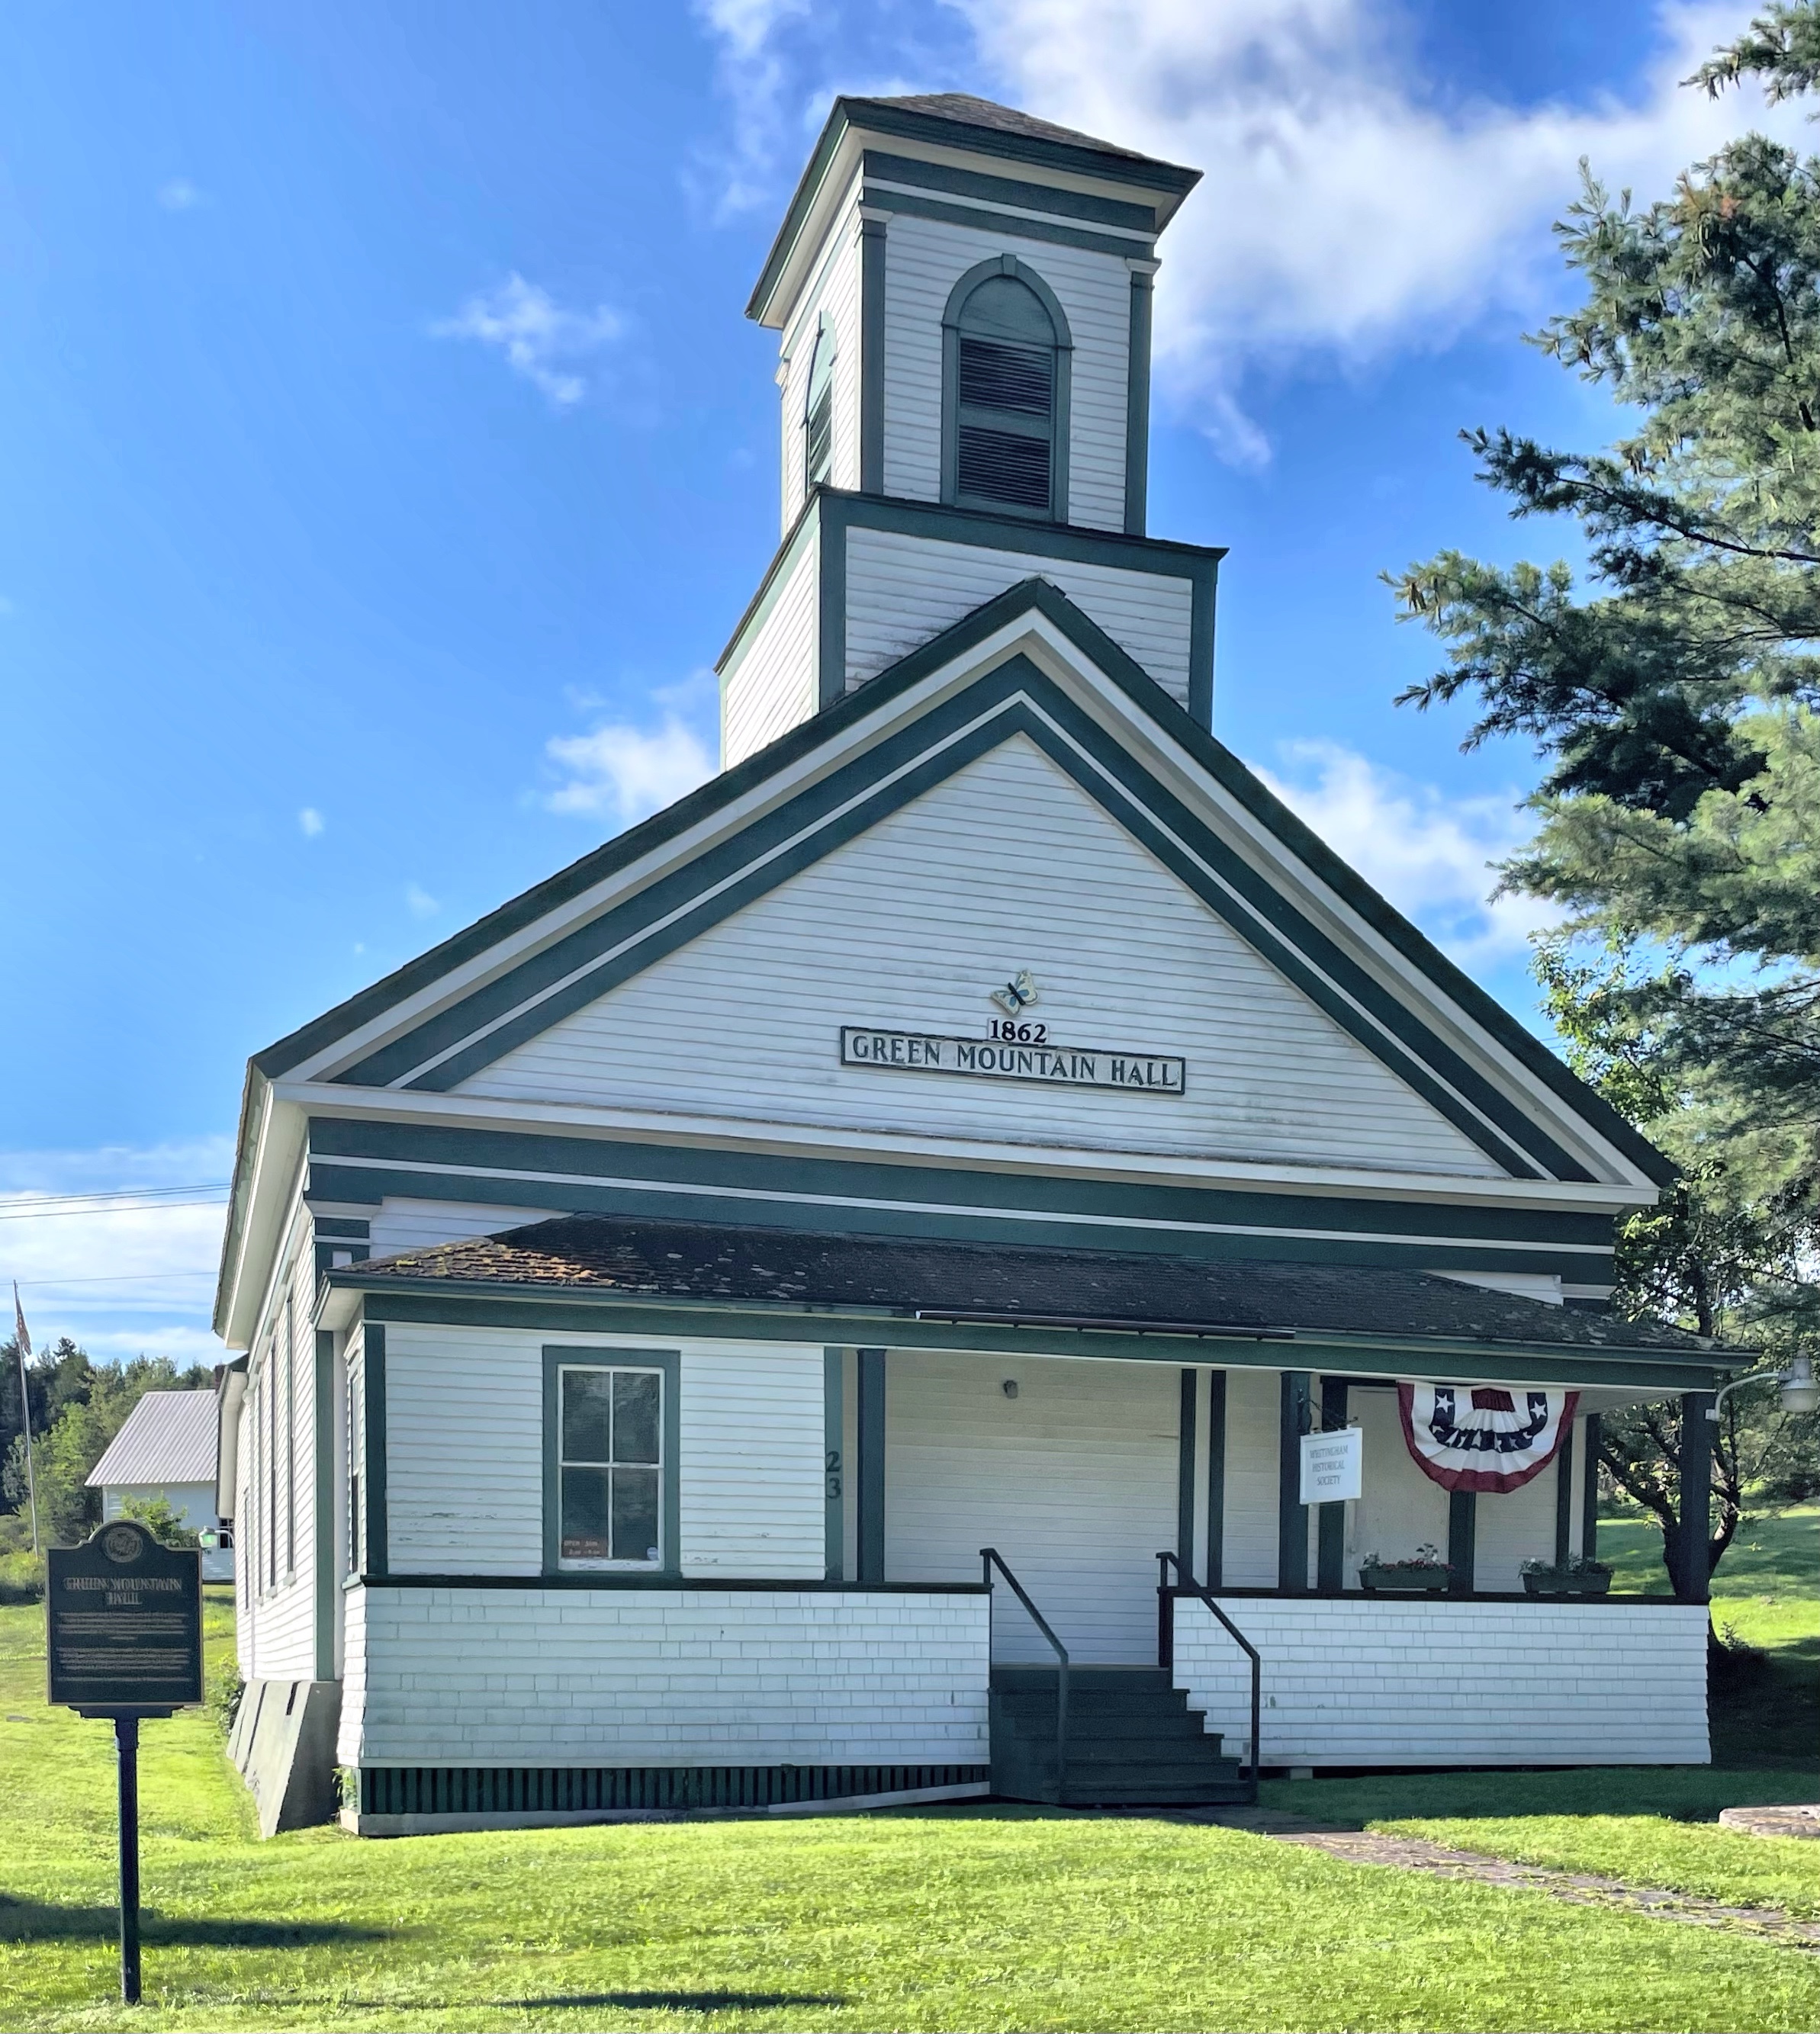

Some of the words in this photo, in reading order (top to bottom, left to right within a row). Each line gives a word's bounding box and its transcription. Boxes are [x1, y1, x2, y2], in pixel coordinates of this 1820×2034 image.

[990, 1020, 1047, 1044] 1862
[853, 1035, 941, 1065] GREEN
[957, 1045, 1096, 1081] MOUNTAIN
[1111, 1059, 1178, 1087] HALL
[1312, 1460, 1345, 1472] HISTORICAL
[1317, 1475, 1341, 1486] SOCIETY
